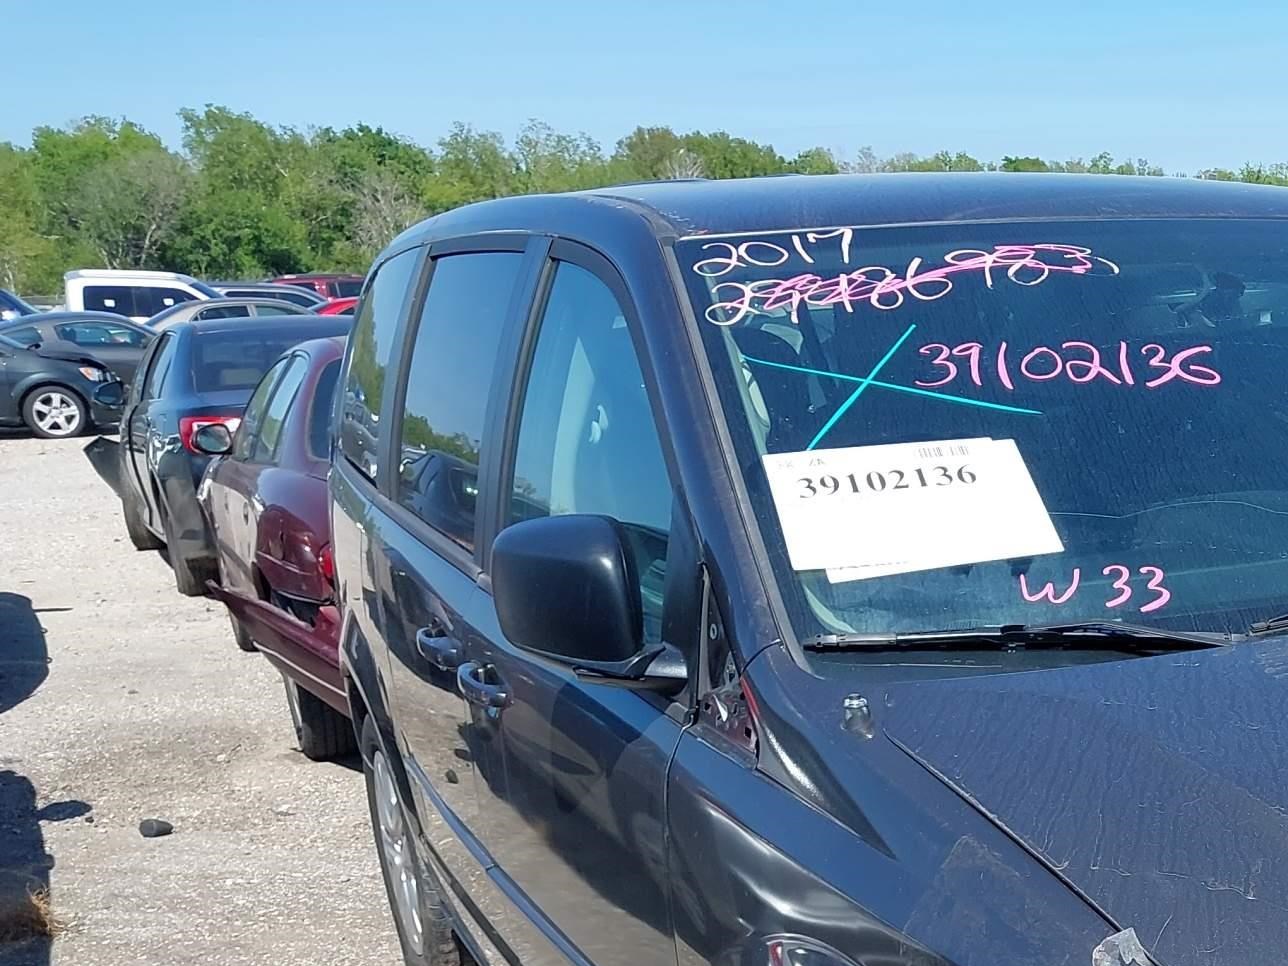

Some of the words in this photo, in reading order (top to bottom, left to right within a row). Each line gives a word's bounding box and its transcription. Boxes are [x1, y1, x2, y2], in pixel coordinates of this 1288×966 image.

[693, 229, 853, 276] 2017
[914, 340, 1222, 390] 39102136
[797, 464, 977, 498] 39102136
[1103, 565, 1171, 612] 33
